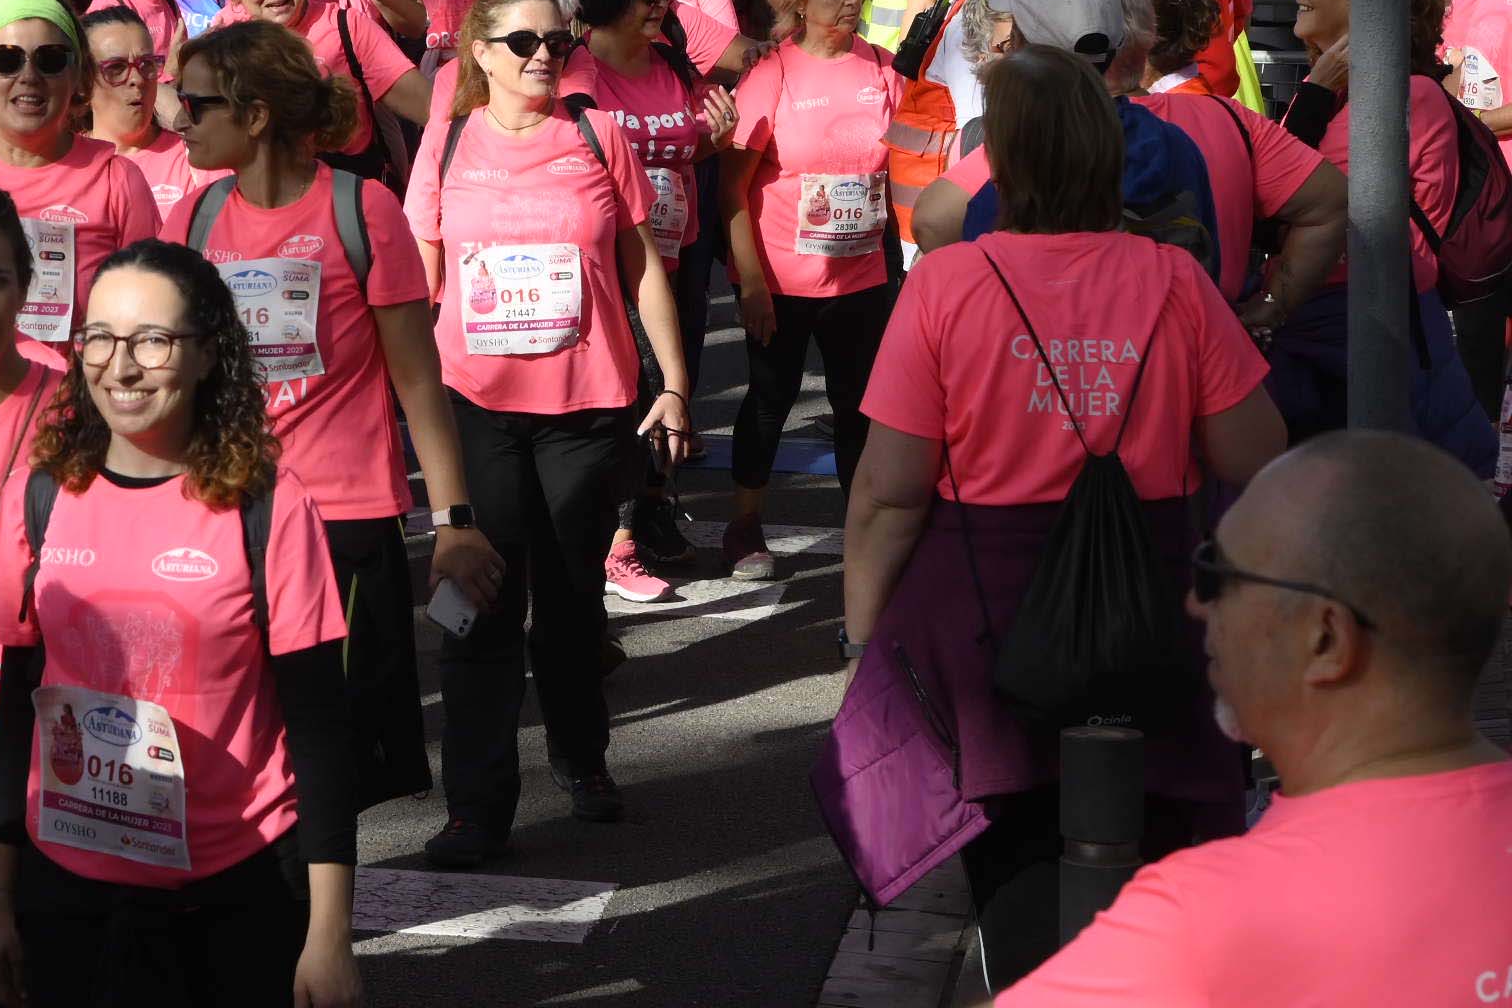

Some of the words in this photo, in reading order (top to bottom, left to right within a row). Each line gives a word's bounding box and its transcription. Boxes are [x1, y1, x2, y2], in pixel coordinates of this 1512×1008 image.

[644, 109, 685, 135] por
[834, 207, 862, 220] 016
[39, 236, 64, 244] SUMA
[548, 256, 573, 264] SUMA
[283, 273, 309, 282] SUMA
[500, 288, 540, 303] 016
[241, 307, 269, 325] 16
[505, 308, 536, 319] 21447
[477, 322, 508, 331] CARRERA
[509, 322, 518, 330] DE
[531, 321, 553, 329] MUJER
[258, 347, 284, 355] MUJER
[1011, 333, 1142, 363] CARRERA
[1079, 363, 1112, 390] LA
[1026, 391, 1120, 417] MUJER
[157, 557, 213, 575] ASTURIANA
[87, 715, 138, 741] ASTURIANA
[148, 724, 170, 737] SUMA
[88, 754, 133, 785] 016
[91, 785, 128, 807] 11188
[58, 797, 90, 815] CARRERA
[93, 806, 106, 817] DE
[108, 808, 118, 819] LA
[119, 811, 149, 826] MUJER
[151, 818, 172, 833] 2023
[54, 819, 96, 840] OYSHO
[131, 836, 176, 858] Santander
